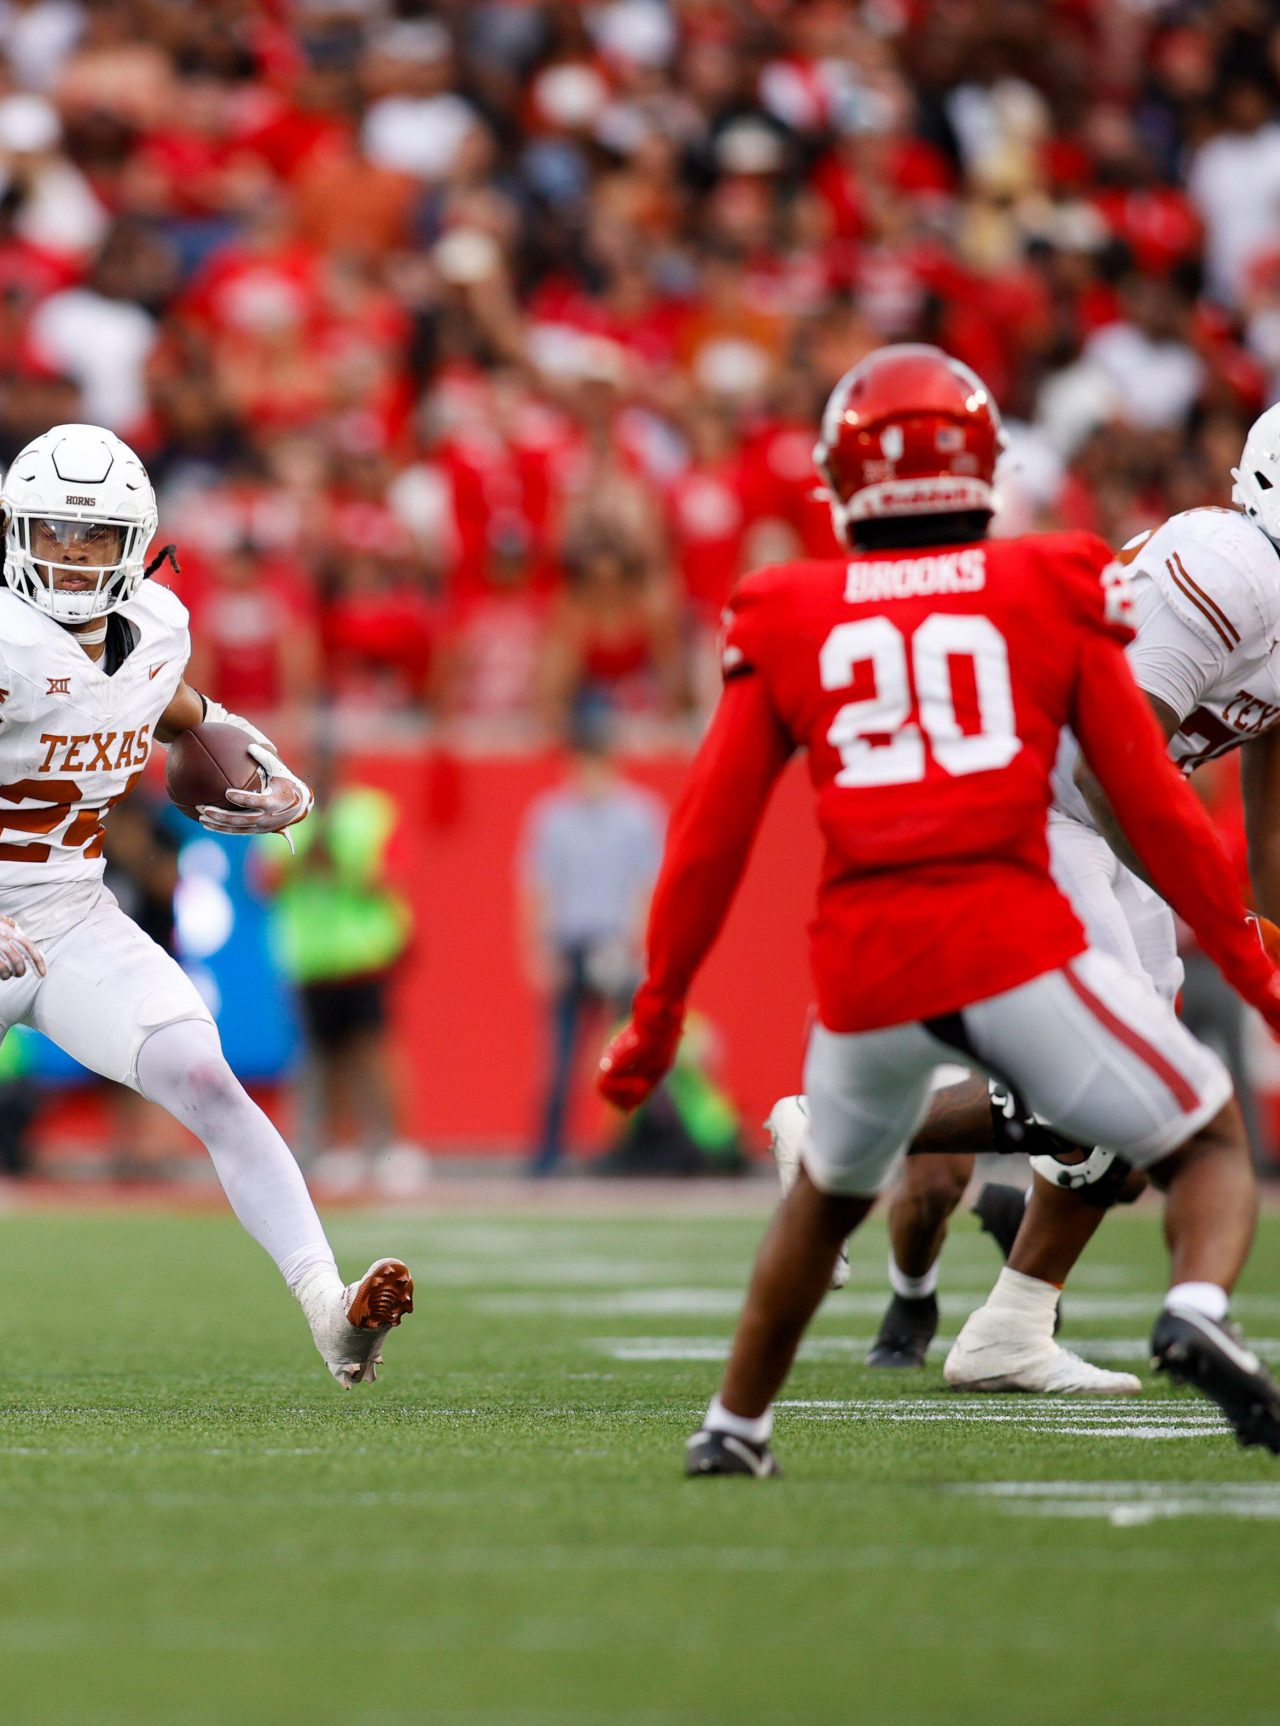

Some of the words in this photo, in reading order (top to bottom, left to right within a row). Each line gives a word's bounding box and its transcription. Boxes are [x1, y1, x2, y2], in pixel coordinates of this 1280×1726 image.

[66, 496, 96, 506] HORNS
[844, 549, 986, 604] BROOKS
[819, 612, 1023, 788] 20
[39, 724, 150, 772] TEXAS
